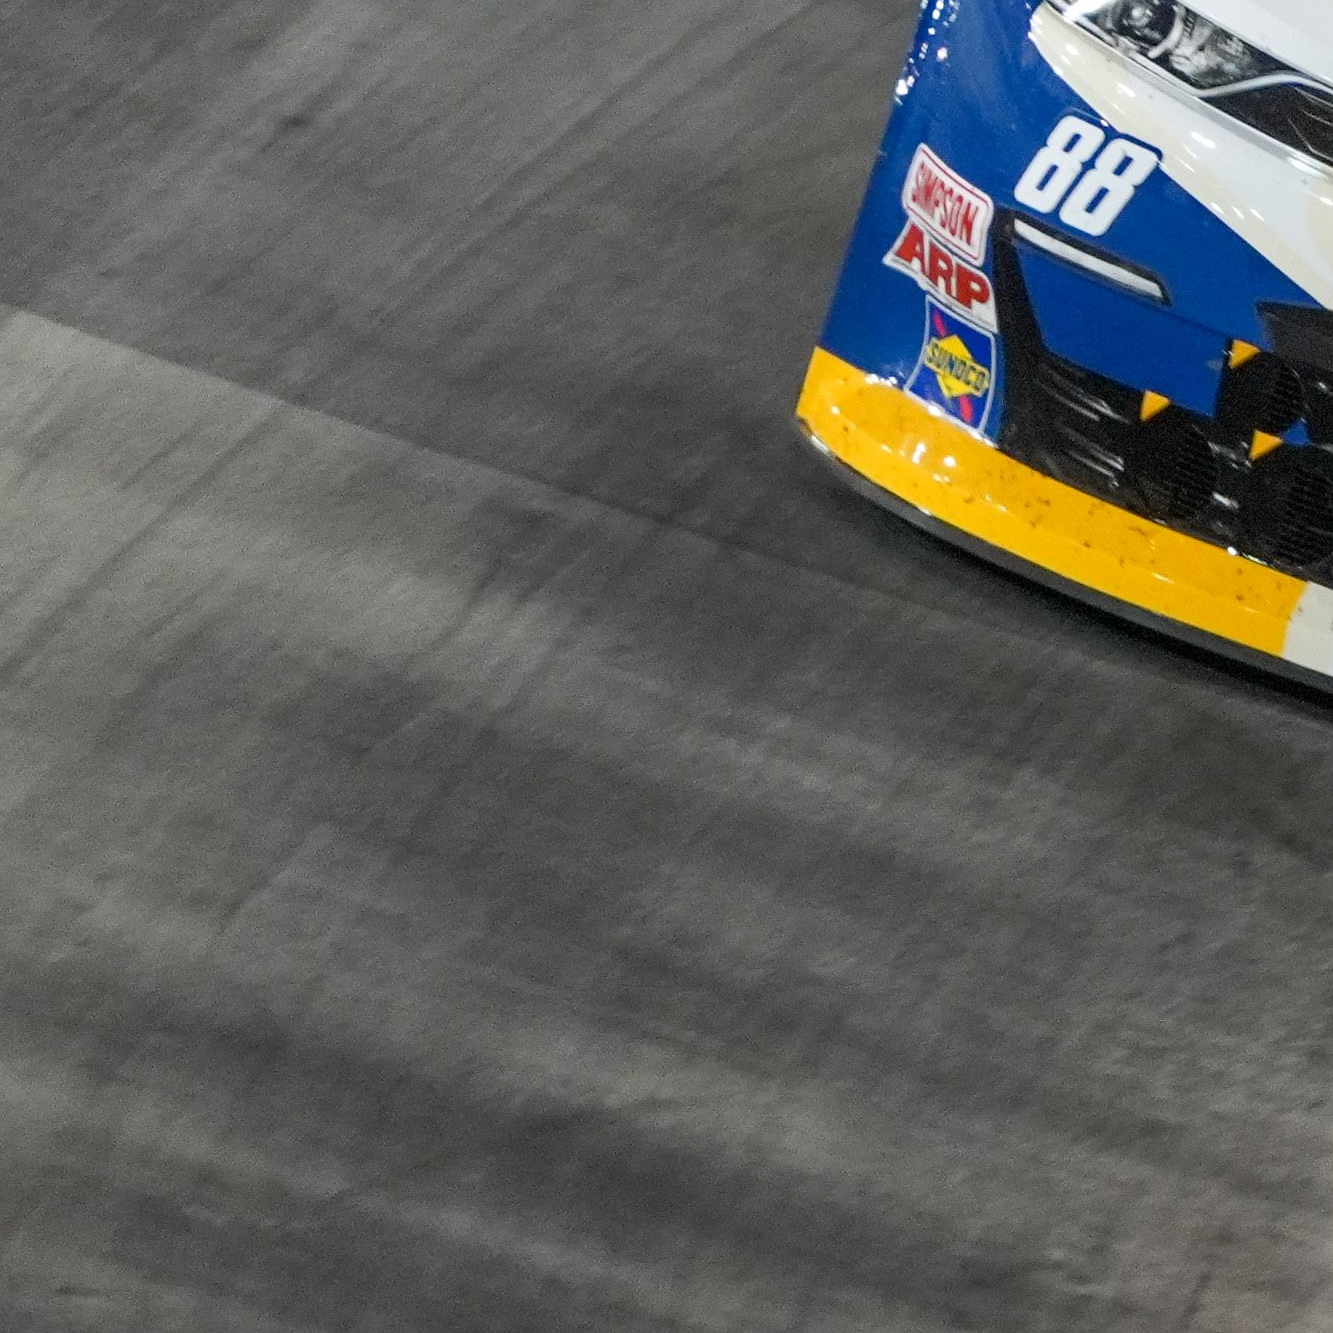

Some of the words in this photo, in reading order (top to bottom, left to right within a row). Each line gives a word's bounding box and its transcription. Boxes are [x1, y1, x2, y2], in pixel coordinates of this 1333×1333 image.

[912, 160, 979, 246] SIMPSON
[1014, 114, 1160, 236] 88
[896, 224, 990, 309] ARP
[927, 341, 988, 392] SUNOCO
